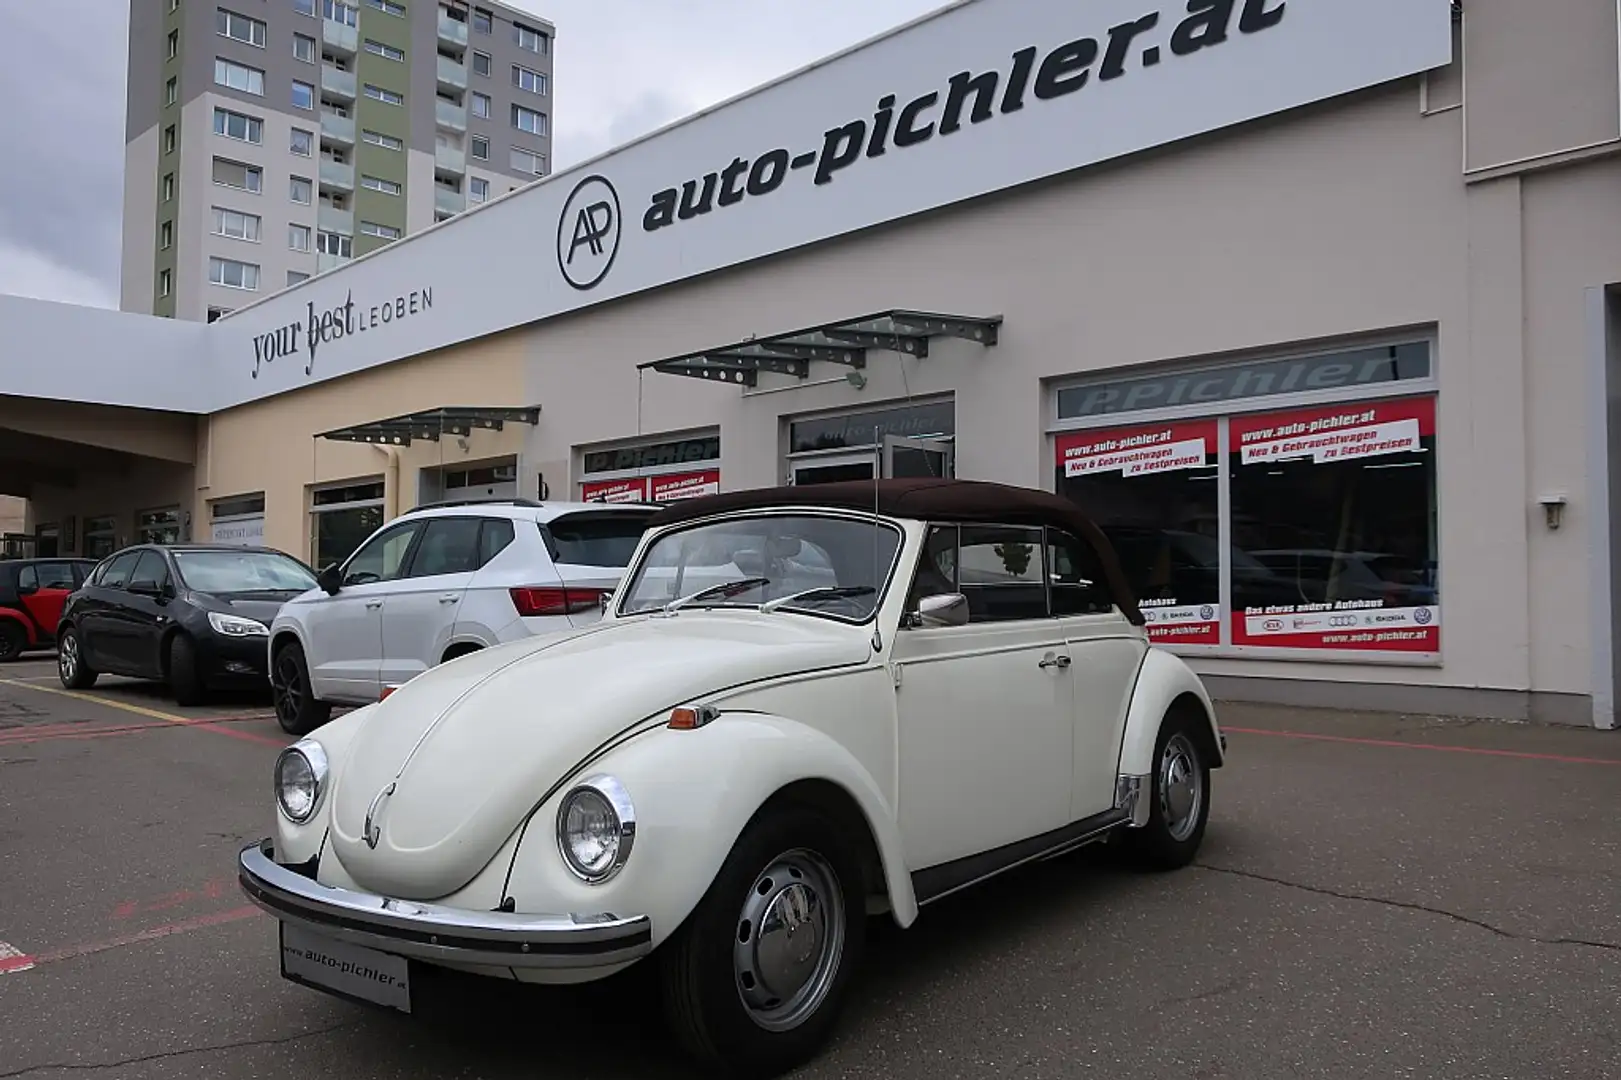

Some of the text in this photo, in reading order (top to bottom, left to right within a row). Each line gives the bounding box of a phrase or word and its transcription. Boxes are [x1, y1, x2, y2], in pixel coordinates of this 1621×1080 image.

[642, 0, 1286, 232] auto-pichler.at
[251, 286, 433, 379] your best LEOBEN
[1065, 429, 1172, 457] www.auto-pichler.at
[1241, 409, 1376, 442] www.auto-pichler.at
